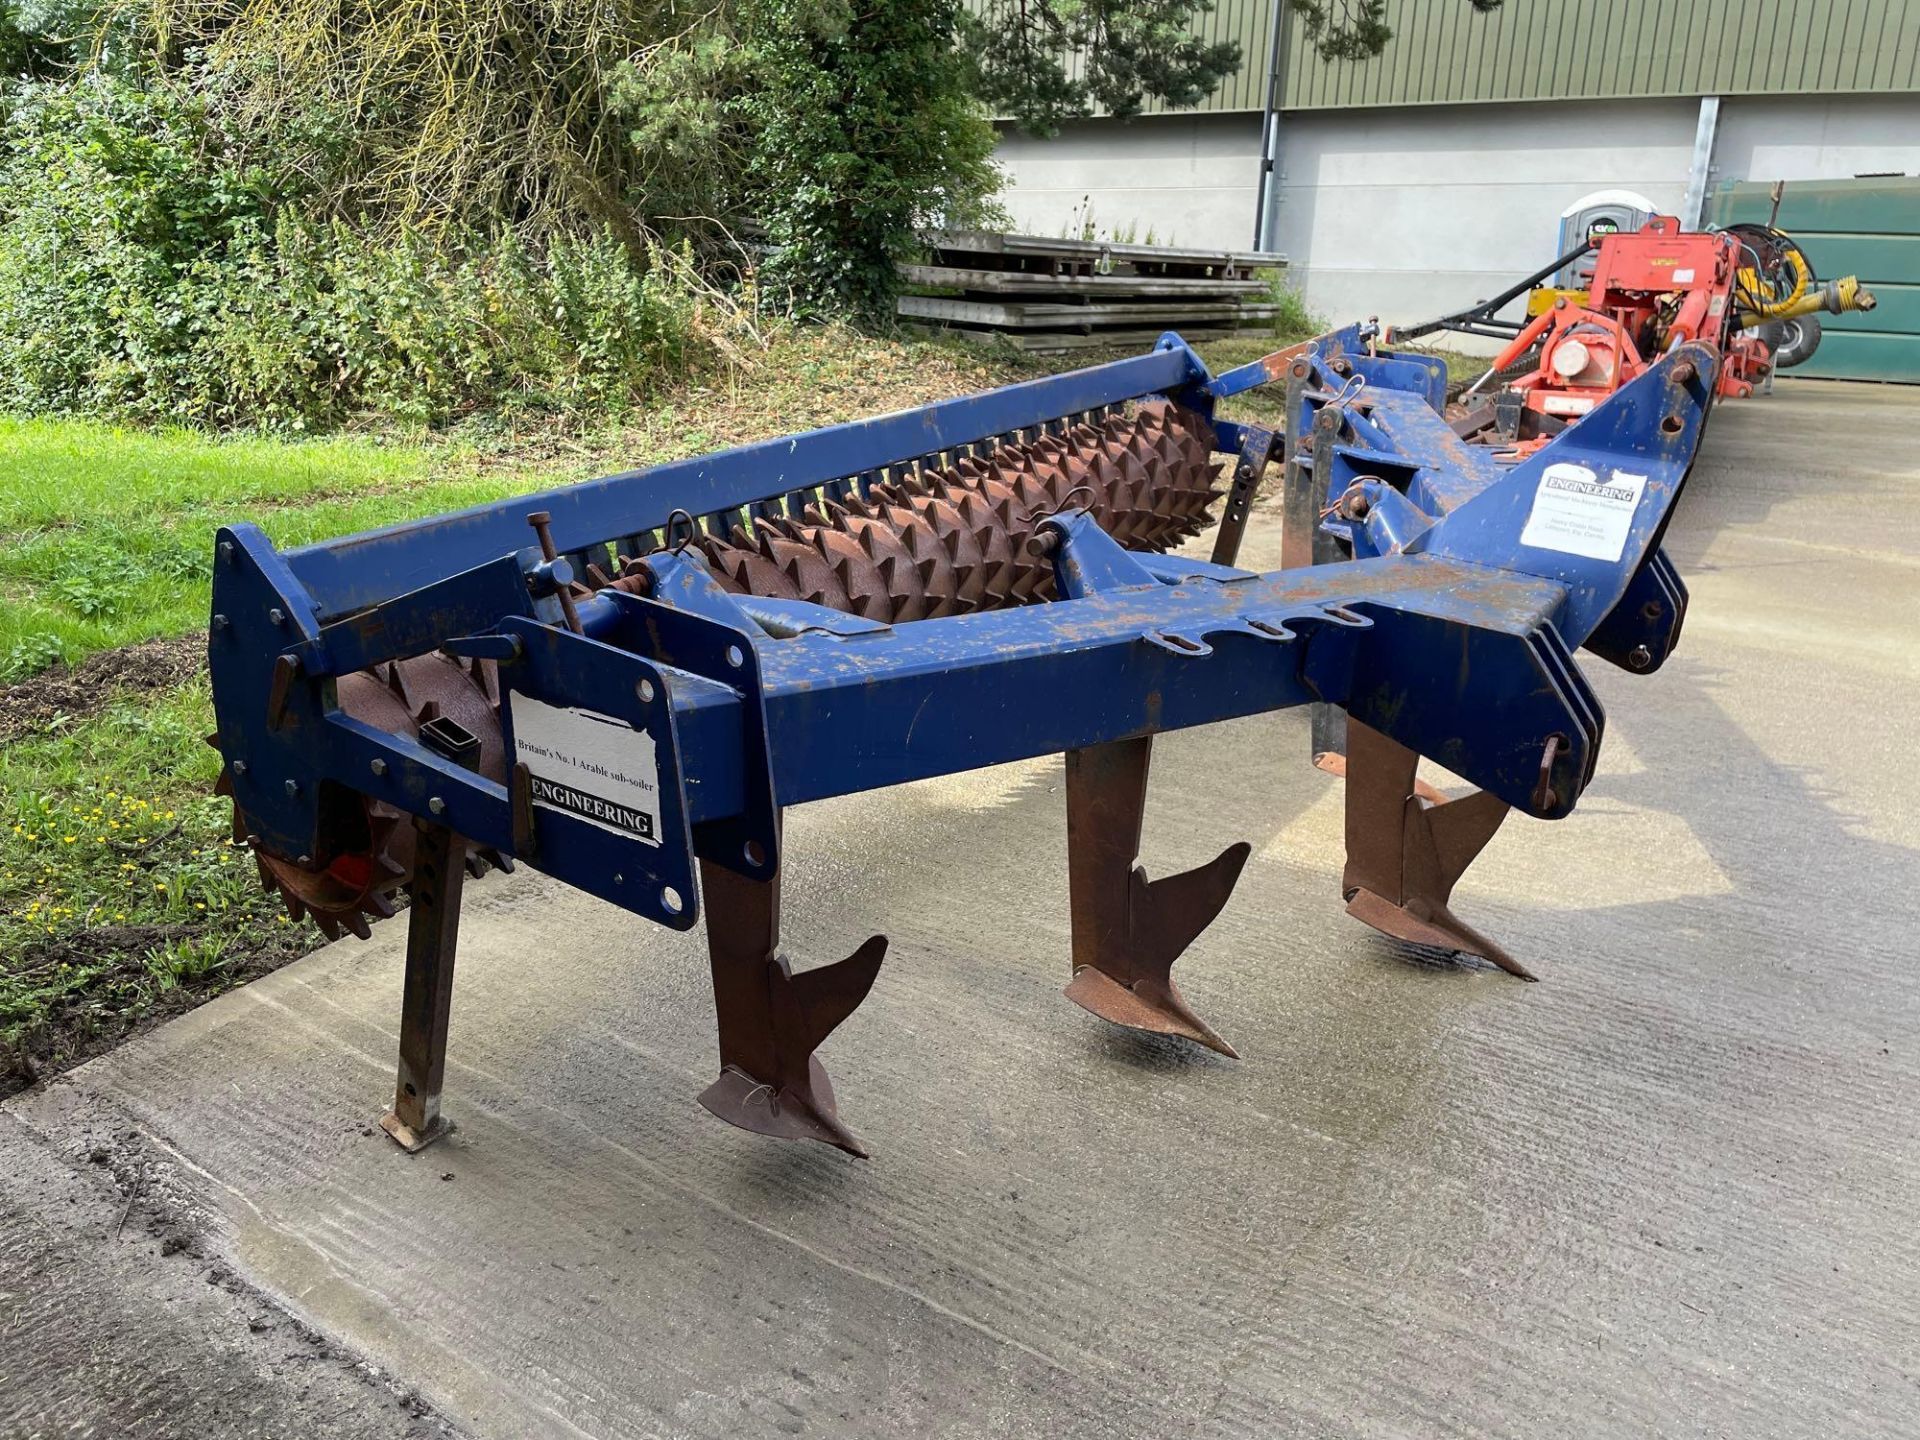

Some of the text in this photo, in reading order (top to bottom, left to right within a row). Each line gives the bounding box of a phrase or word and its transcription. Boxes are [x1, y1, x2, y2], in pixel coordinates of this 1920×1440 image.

[1549, 478, 1633, 501] ENGINEERING
[518, 739, 654, 792] Britain's No. 1 Arable sub-soiler
[531, 778, 649, 833] ENGINEERING
